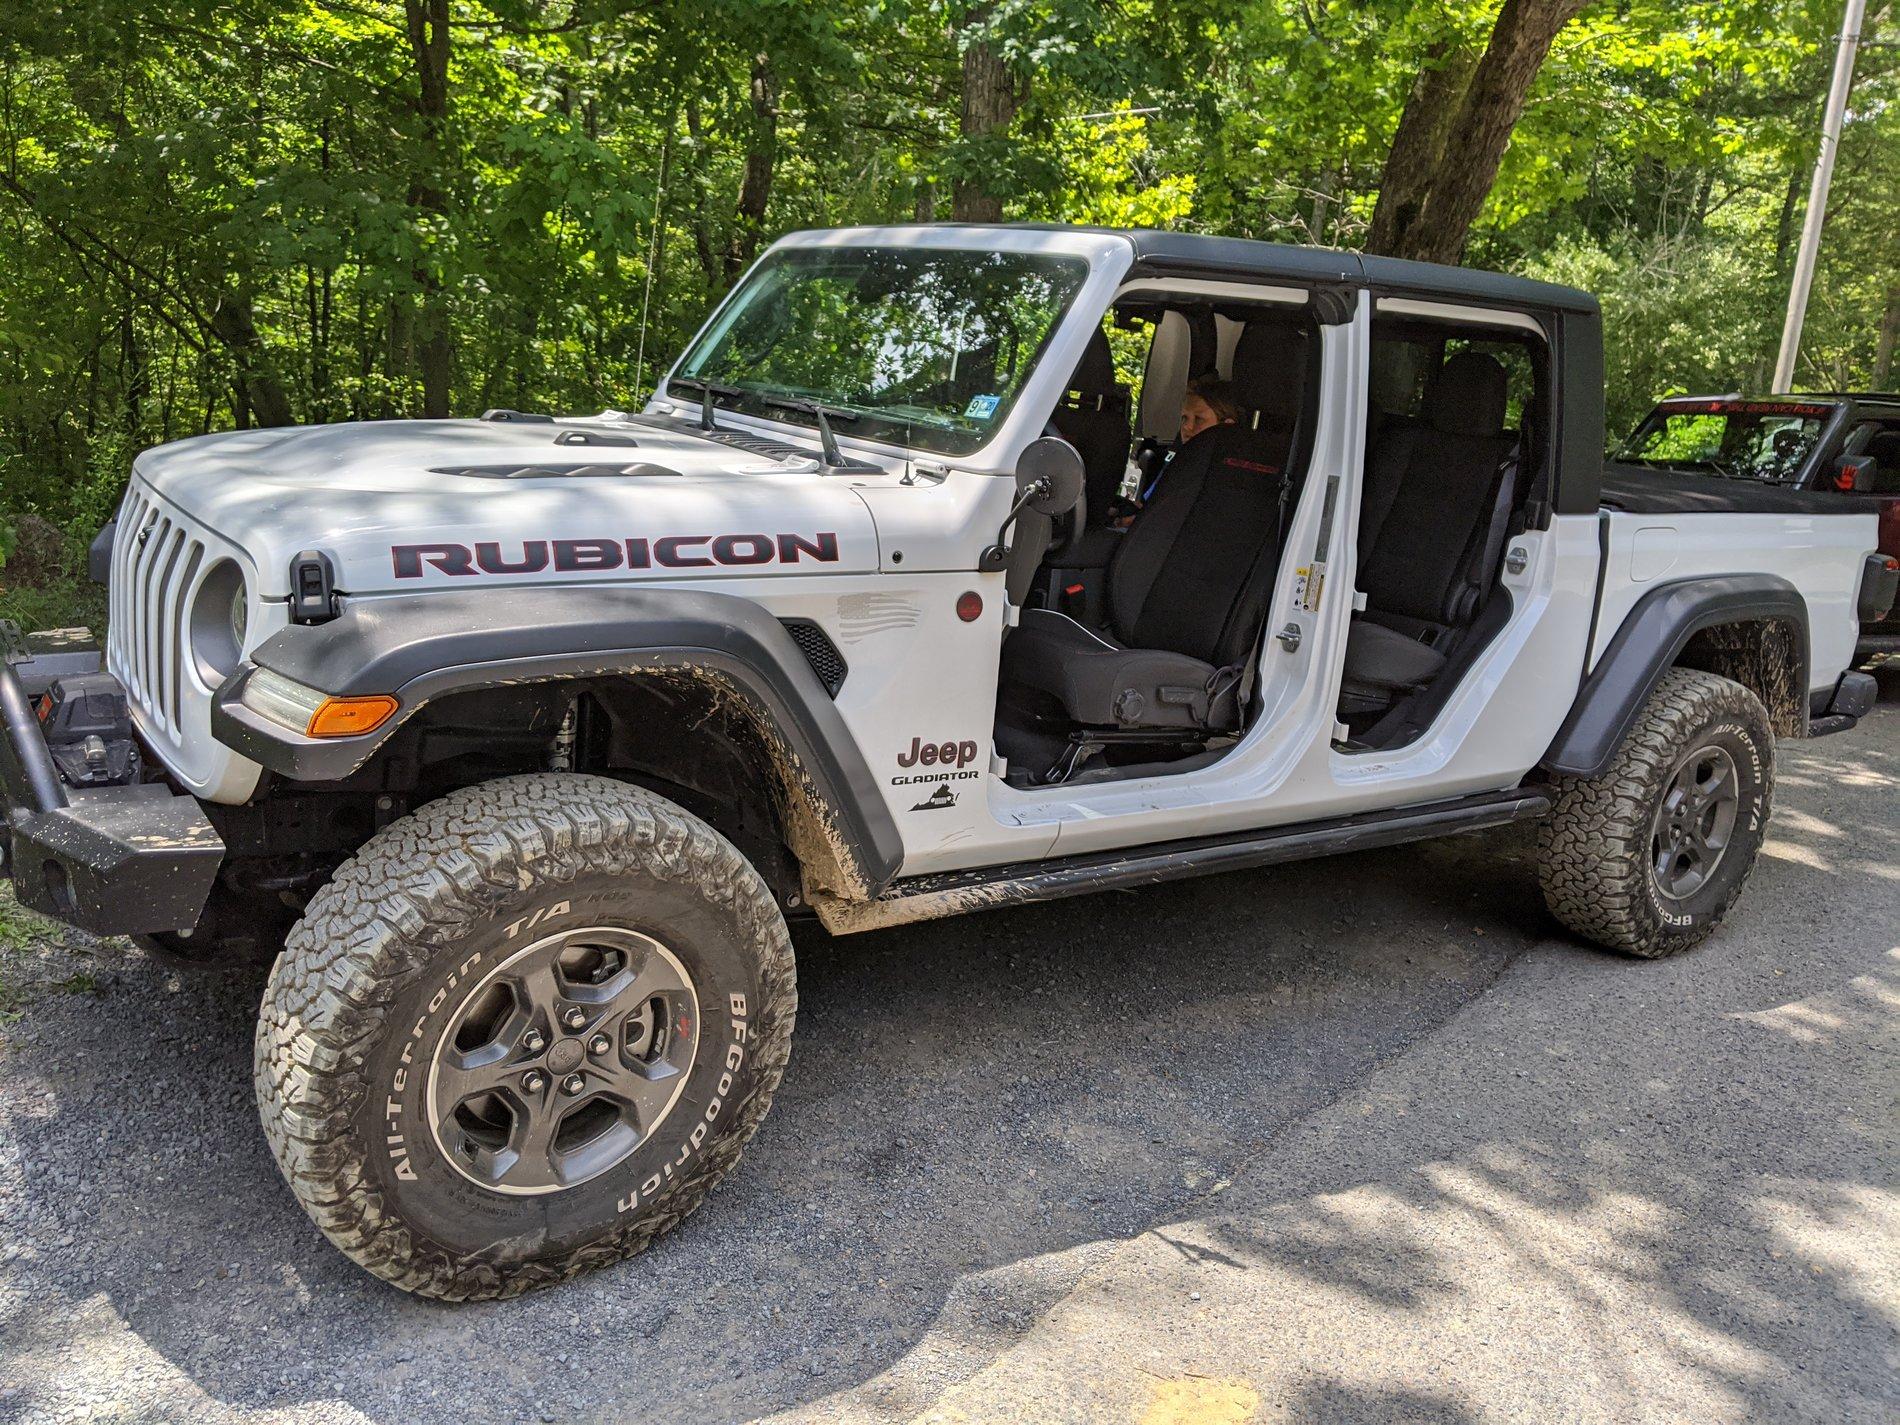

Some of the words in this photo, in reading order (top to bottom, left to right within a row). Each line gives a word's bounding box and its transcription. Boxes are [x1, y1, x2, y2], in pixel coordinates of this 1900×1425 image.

[969, 400, 980, 412] 9
[391, 532, 839, 579] RUBICON
[897, 737, 978, 769] Jeep
[891, 771, 979, 786] GLADIATOR
[1748, 794, 1763, 831] T/A
[387, 951, 481, 1181] All-Terrain
[503, 899, 571, 939] T/A
[617, 992, 748, 1213] BFGoodrich
